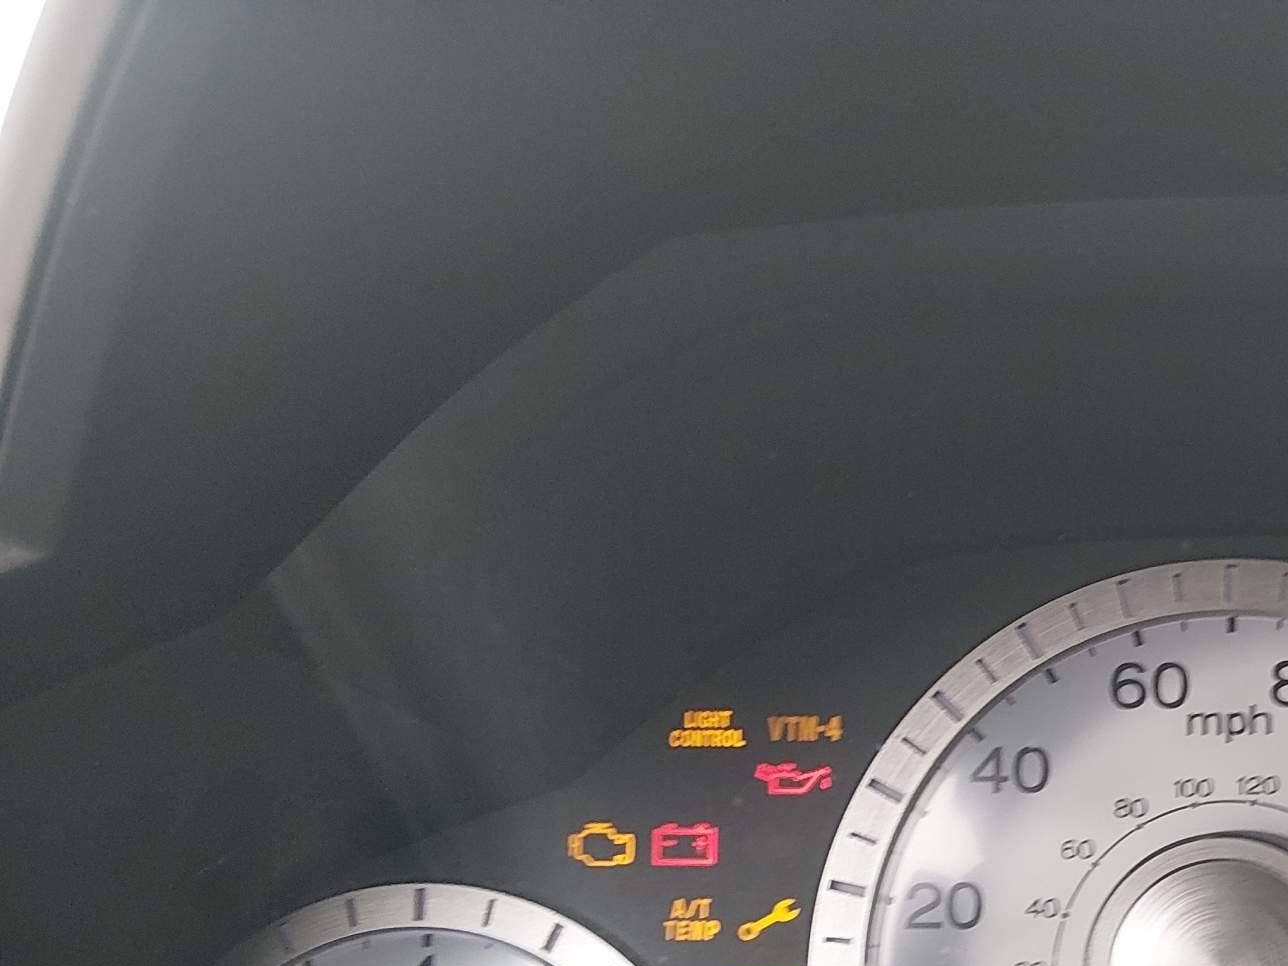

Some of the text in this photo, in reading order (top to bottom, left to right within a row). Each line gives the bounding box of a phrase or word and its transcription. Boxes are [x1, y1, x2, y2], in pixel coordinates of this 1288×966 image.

[1112, 662, 1189, 708] 60
[683, 710, 734, 728] LIGHT
[1185, 706, 1274, 743] mph
[668, 729, 747, 748] CONTROL
[971, 747, 1049, 793] 40
[1173, 778, 1214, 798] 100
[1237, 776, 1280, 796] 120
[1113, 798, 1148, 818] 80
[1060, 839, 1096, 860] 60
[669, 898, 712, 918] A/T
[905, 881, 983, 930] 20
[1025, 898, 1060, 918] 40
[663, 919, 721, 941] TEMP
